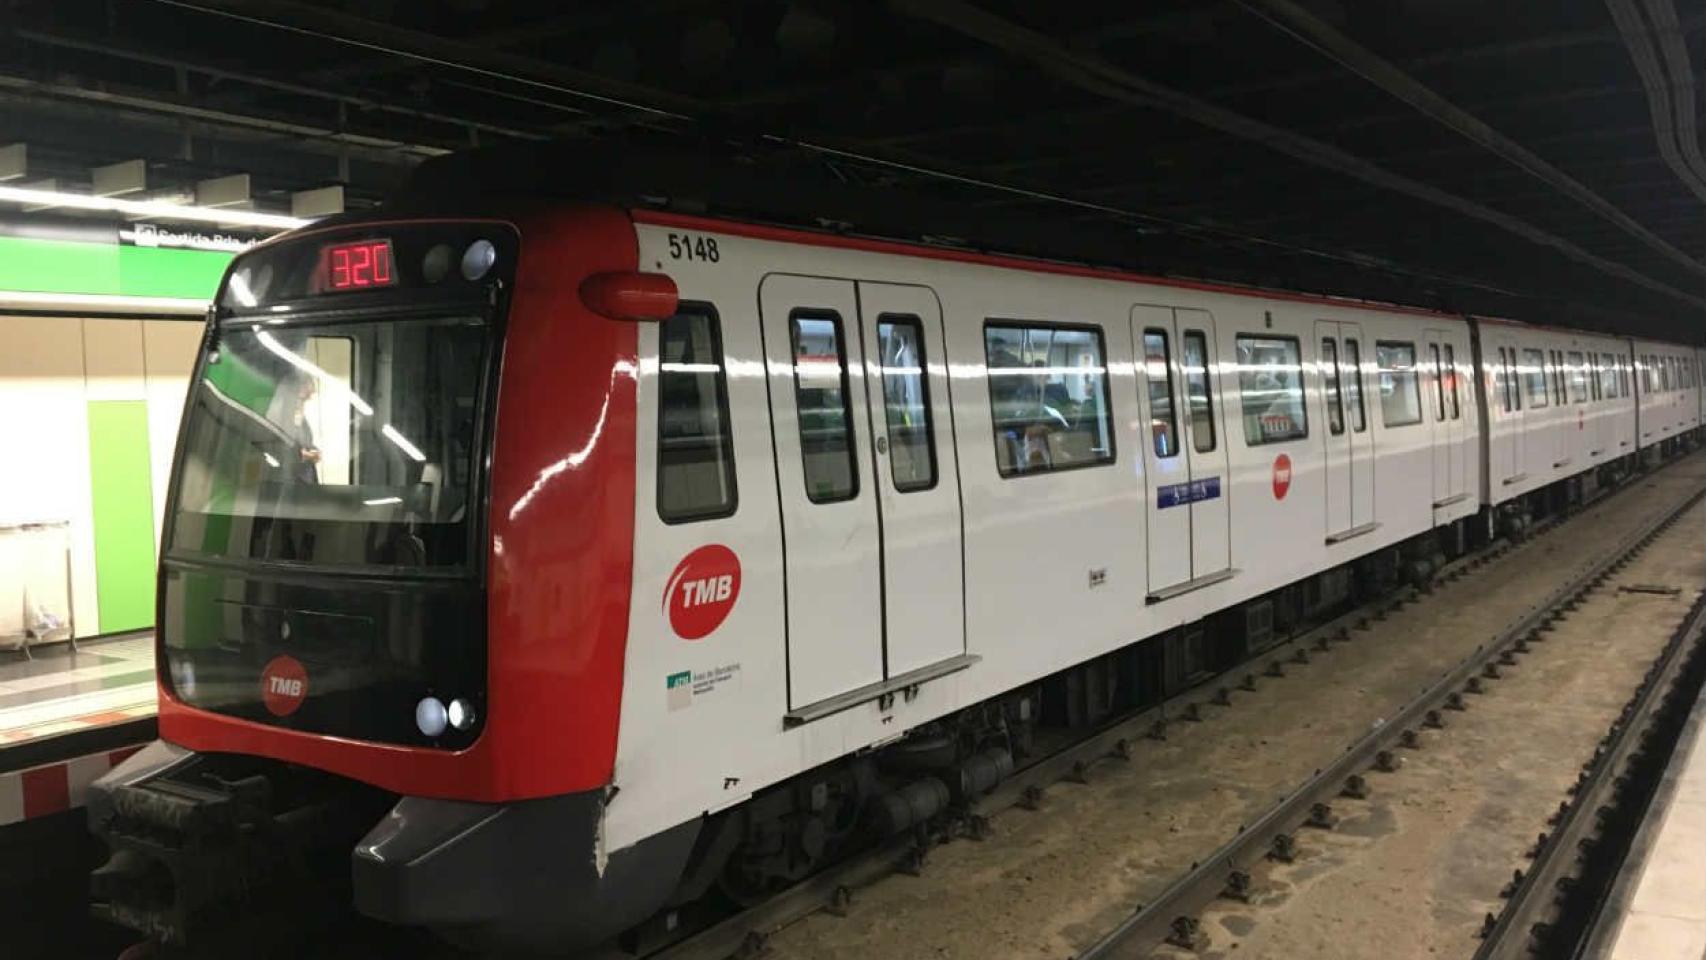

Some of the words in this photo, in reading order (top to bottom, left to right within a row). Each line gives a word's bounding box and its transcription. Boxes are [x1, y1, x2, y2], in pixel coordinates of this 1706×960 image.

[668, 233, 720, 262] 5148
[333, 244, 389, 287] 320
[682, 574, 733, 608] TMB
[270, 676, 301, 696] TMB
